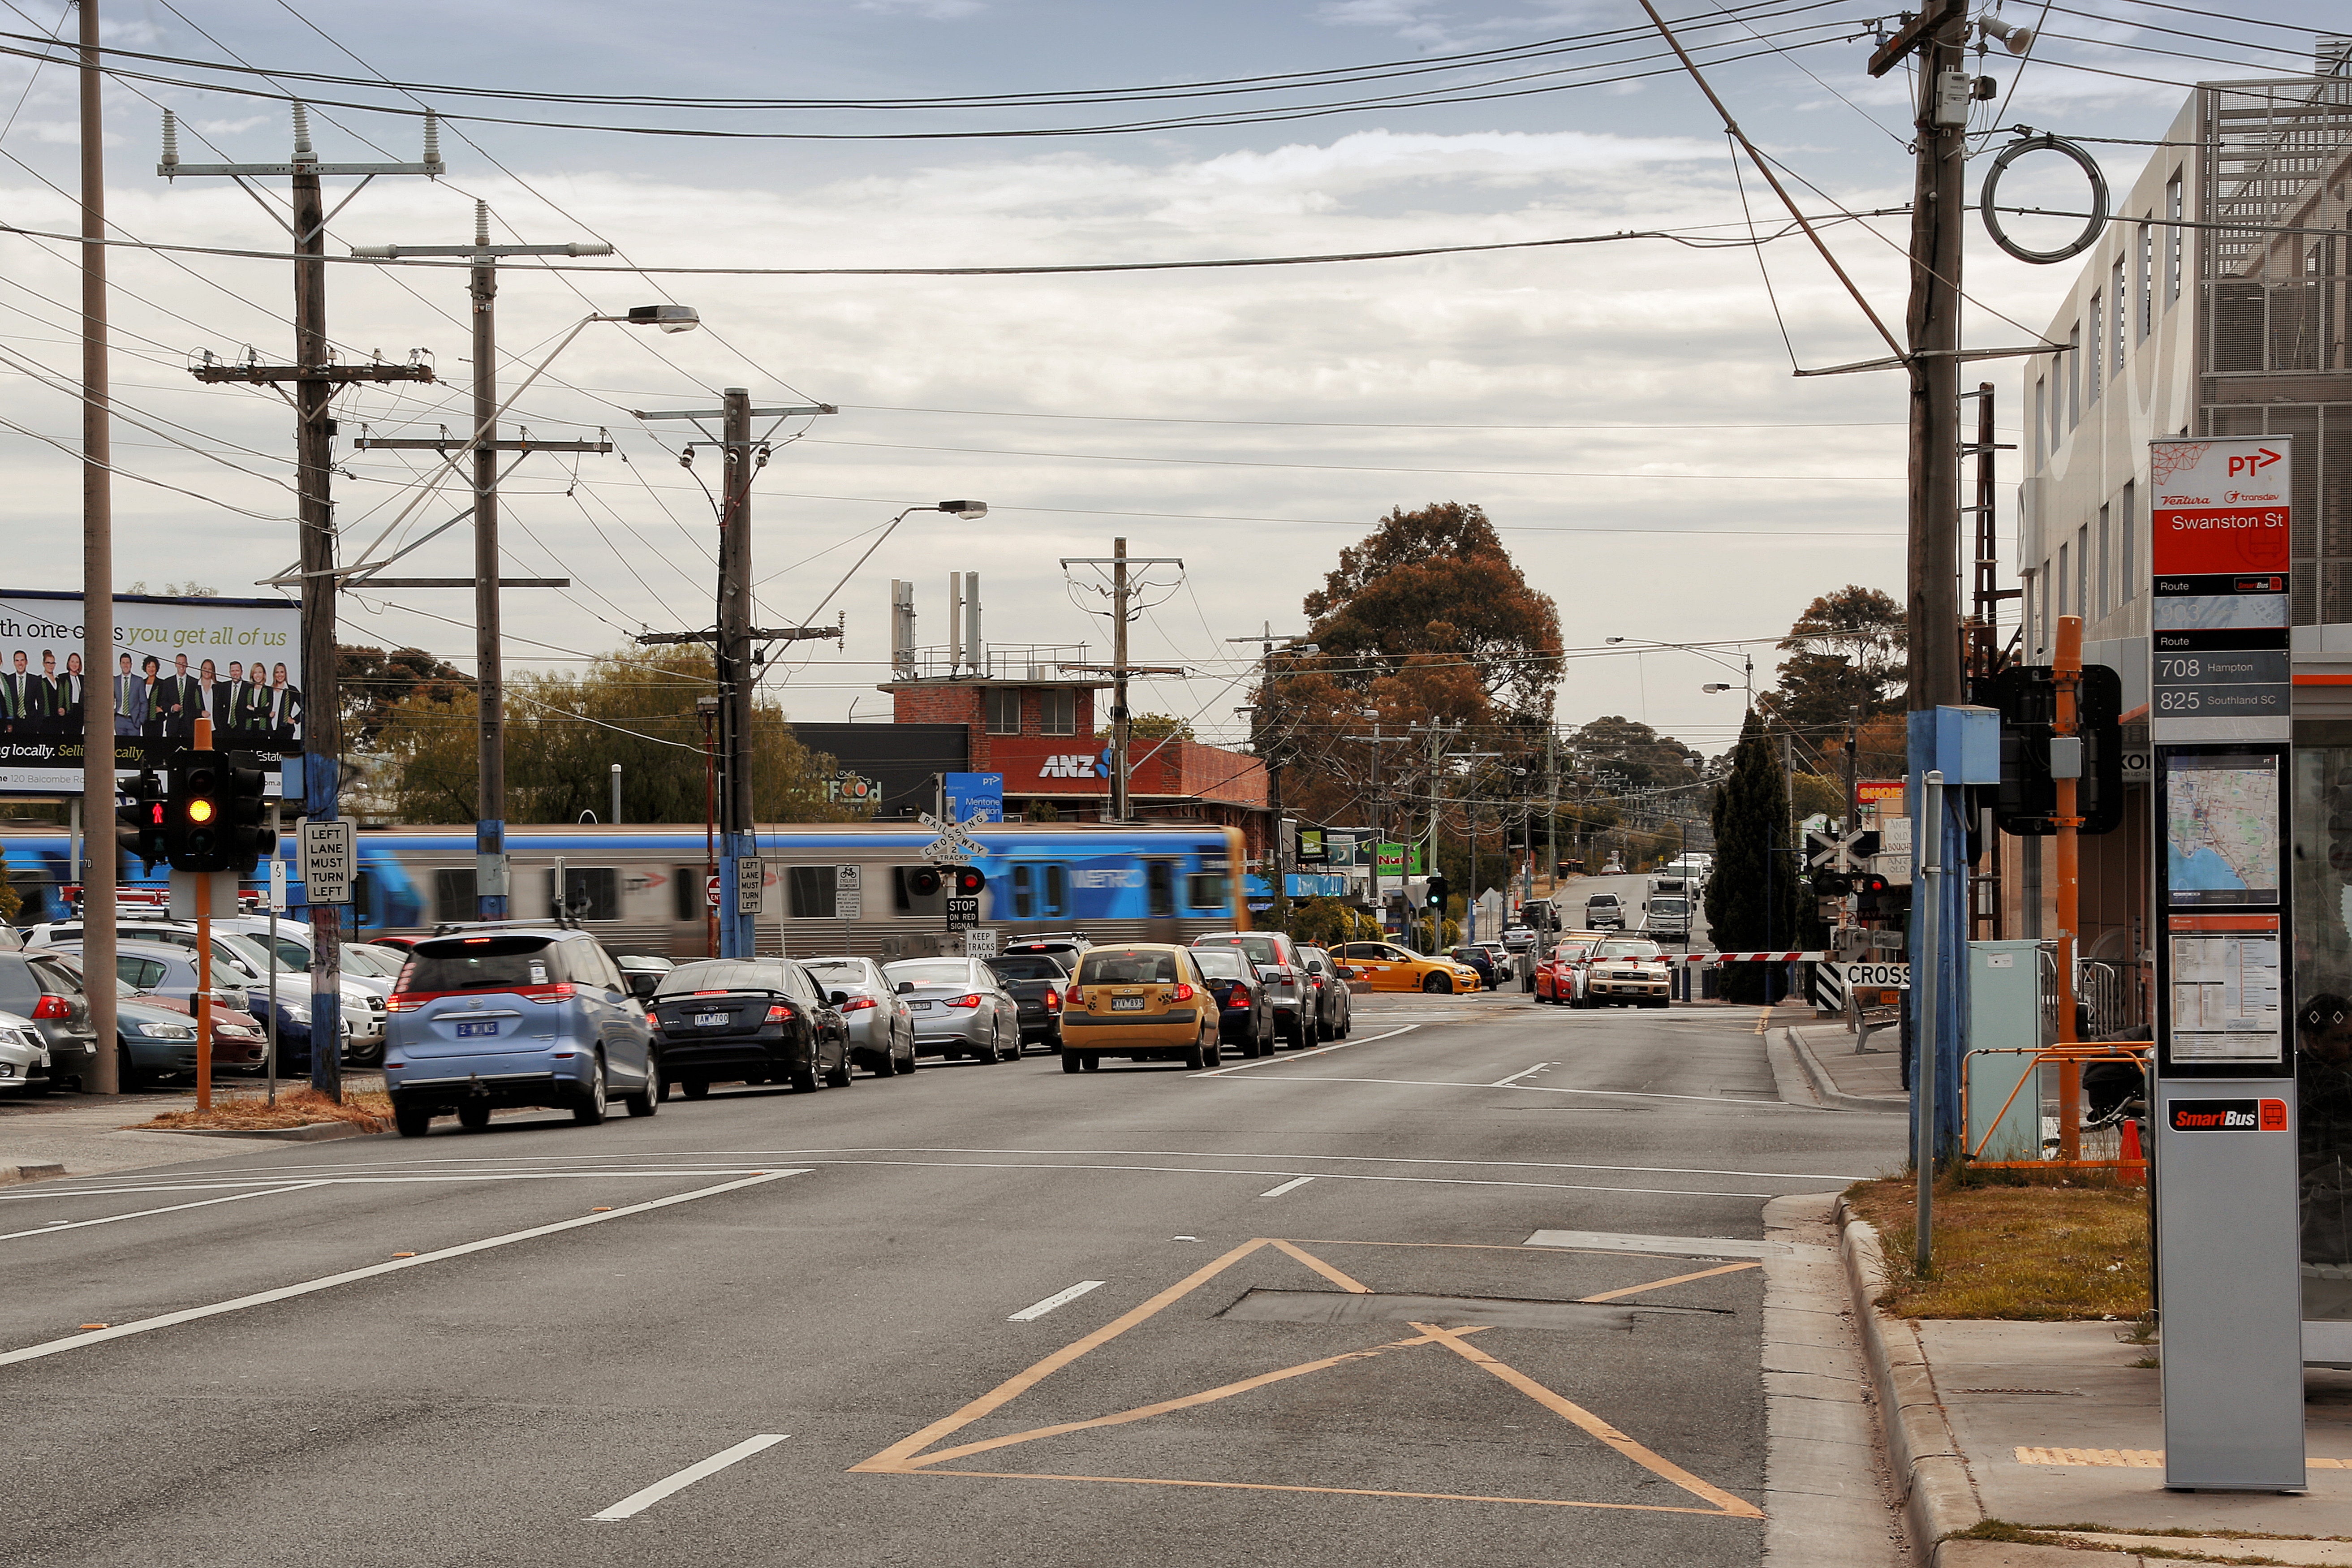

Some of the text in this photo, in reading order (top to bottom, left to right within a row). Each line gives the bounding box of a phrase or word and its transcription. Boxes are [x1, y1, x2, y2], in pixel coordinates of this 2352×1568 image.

[2161, 495, 2210, 506] Ventura
[2172, 513, 2283, 530] Swanston St
[2160, 582, 2189, 591] Route
[2161, 605, 2200, 622] 903
[27, 624, 67, 638] one
[73, 625, 84, 639] o
[113, 627, 123, 641] s
[127, 628, 168, 646] you
[173, 628, 206, 648] get
[210, 627, 233, 645] all
[238, 628, 261, 645] of
[263, 632, 287, 646] us
[2161, 638, 2189, 646] Route
[2160, 659, 2253, 677] 708 Hampton
[2160, 692, 2276, 710] 825 Southland SC
[13, 744, 55, 759] locally.
[58, 745, 84, 757] Selli
[115, 746, 144, 761] cally
[1038, 755, 1095, 777] ANZ
[28, 775, 70, 783] Balcombe
[1860, 788, 1904, 799] SHOE
[312, 830, 340, 840] LEFT
[925, 815, 982, 855] CROSSING
[1894, 832, 1908, 840] OLD
[311, 844, 343, 853] LANE
[311, 858, 343, 868] MUST
[1378, 852, 1415, 866] Nais
[312, 872, 343, 882] TURN
[314, 887, 342, 896] LEFT
[949, 900, 976, 911] STOP
[2176, 1111, 2256, 1126] SmartBus
